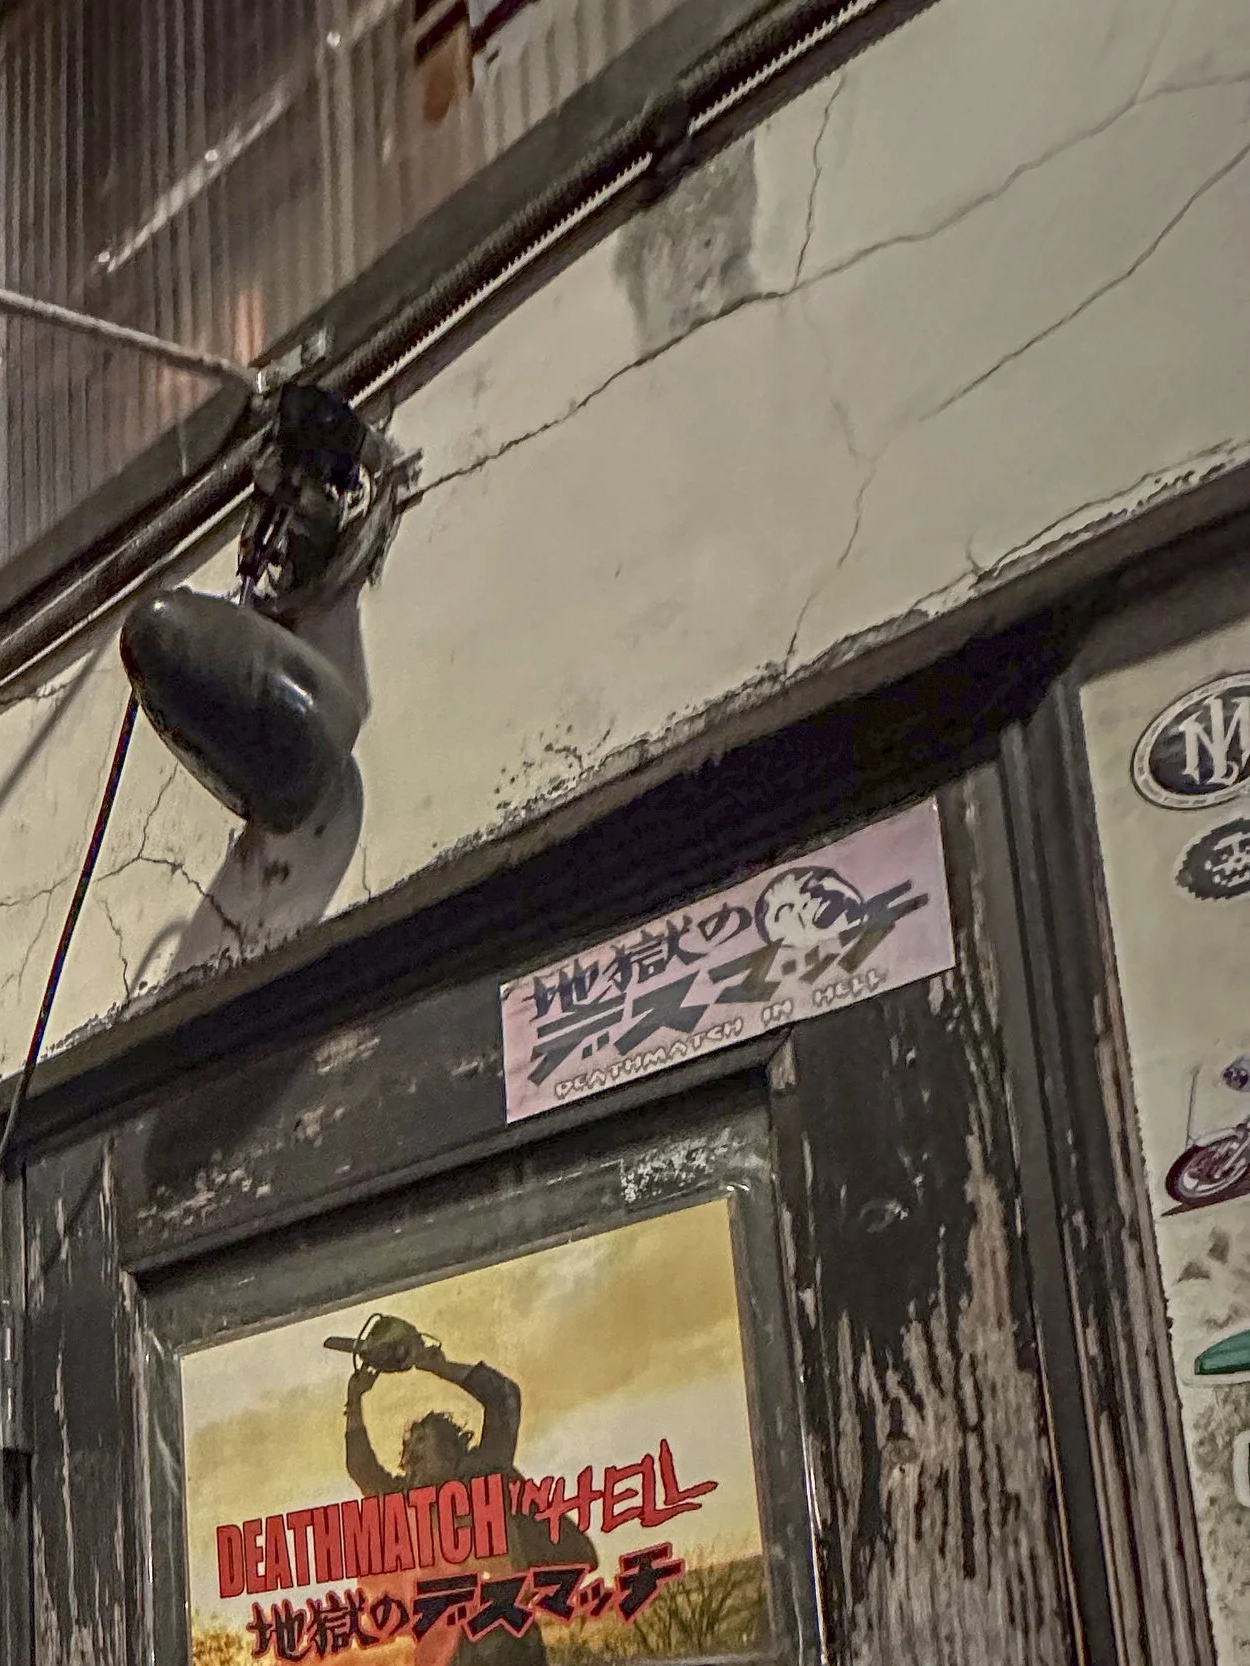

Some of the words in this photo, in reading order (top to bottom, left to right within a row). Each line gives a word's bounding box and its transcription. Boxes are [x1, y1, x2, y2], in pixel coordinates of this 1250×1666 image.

[524, 902, 753, 1021] 地獄の
[527, 879, 929, 1086] デスマッチ
[554, 1017, 744, 1099] DEATHMATCH
[761, 999, 793, 1027] IN
[812, 969, 888, 1006] HELL
[216, 1474, 508, 1599] DEATHMATCH
[538, 1438, 719, 1544] HELL
[247, 1542, 686, 1663] 地獄のデスマッチ
